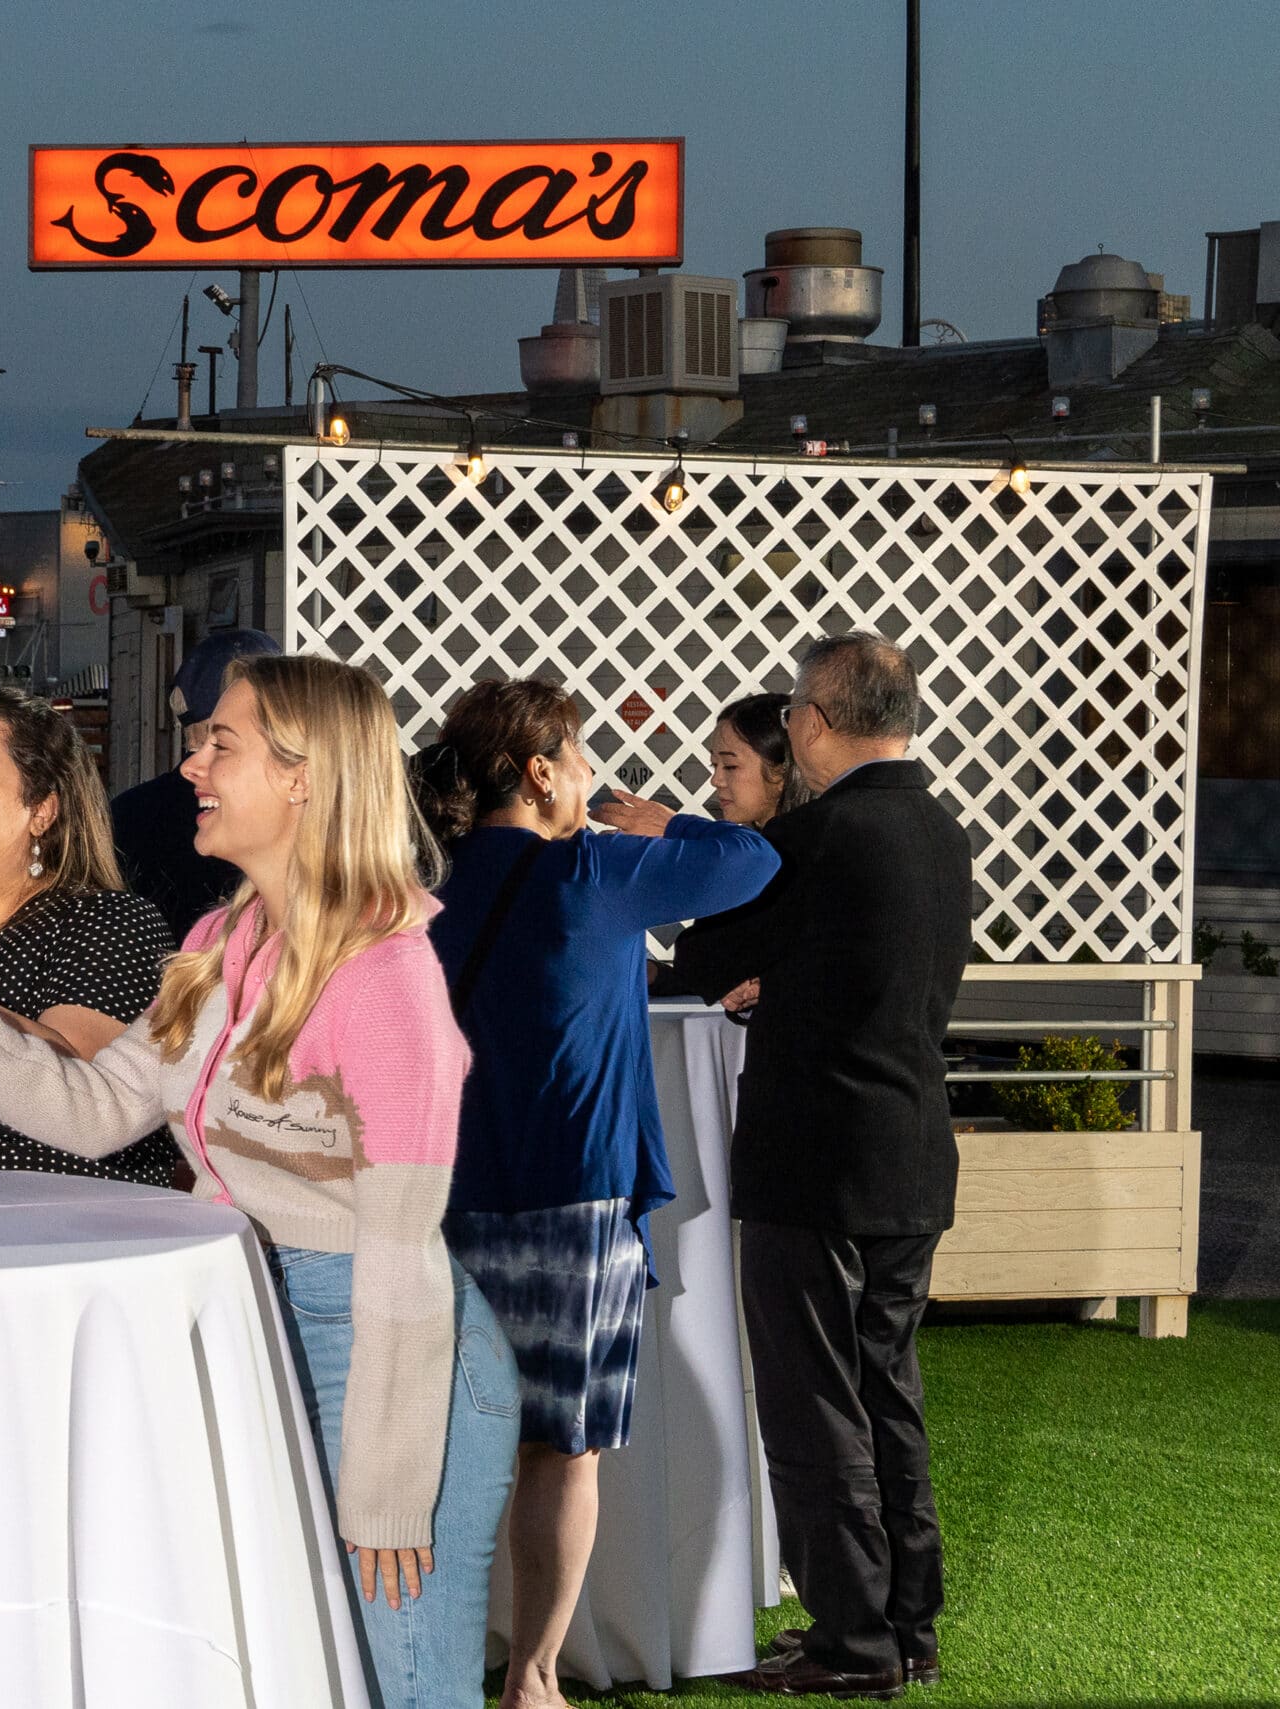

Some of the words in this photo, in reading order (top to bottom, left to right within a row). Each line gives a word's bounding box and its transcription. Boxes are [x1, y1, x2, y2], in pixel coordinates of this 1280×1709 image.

[51, 151, 648, 259] Scoma's
[227, 1097, 264, 1123] House
[263, 1114, 290, 1133] of
